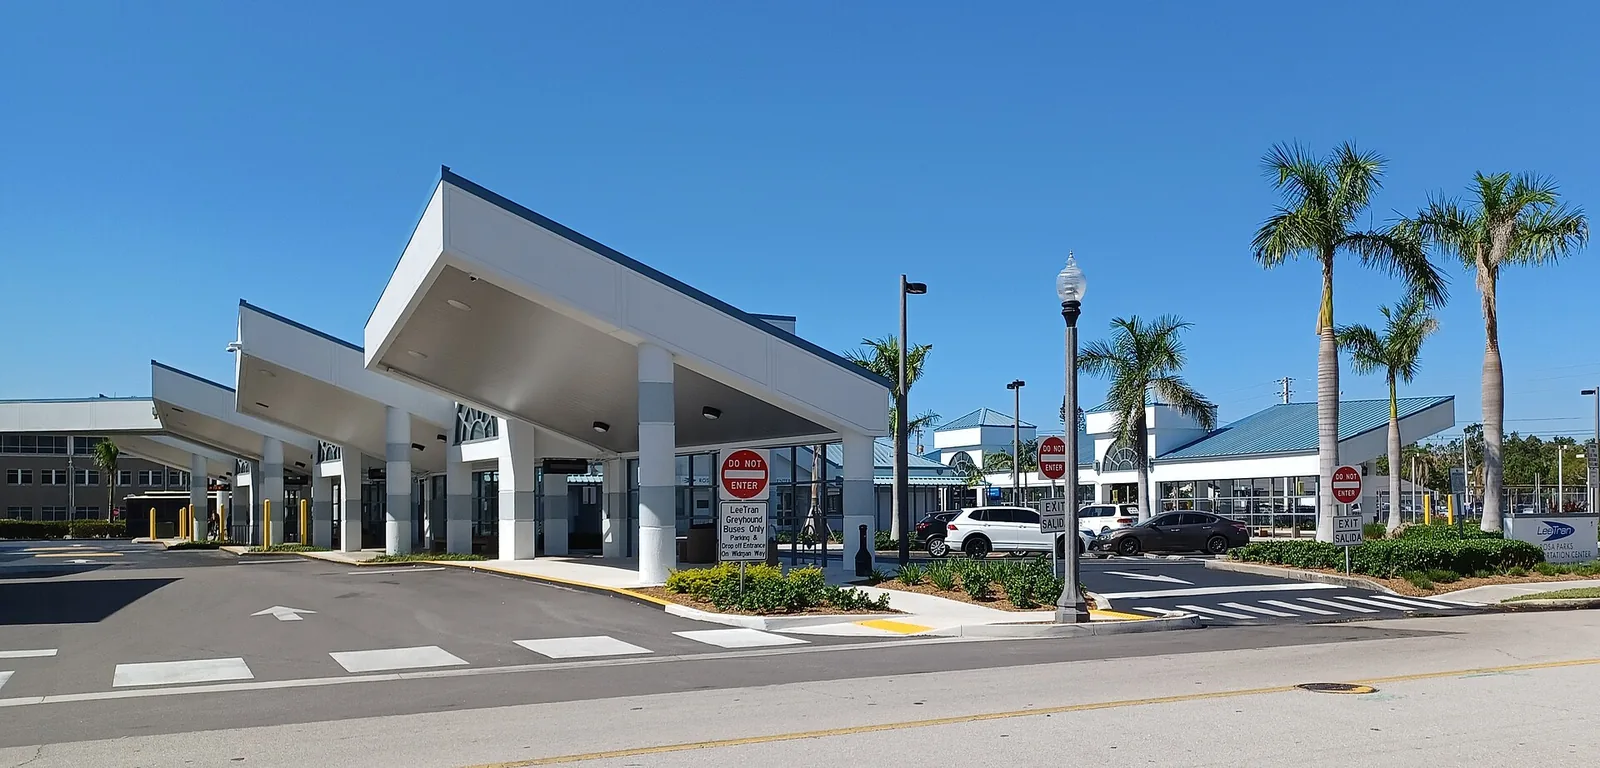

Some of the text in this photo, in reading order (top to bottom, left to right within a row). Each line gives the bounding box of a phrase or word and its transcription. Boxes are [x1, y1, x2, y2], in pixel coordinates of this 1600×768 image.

[731, 482, 758, 490] ENTER
[1046, 501, 1065, 512] EXIT
[726, 516, 762, 525] Greyhound
[1043, 518, 1065, 529] SALID
[1338, 520, 1358, 528] EXIT
[749, 525, 764, 534] Only
[1537, 526, 1571, 535] LeeTran
[1335, 534, 1362, 543] SALIDA
